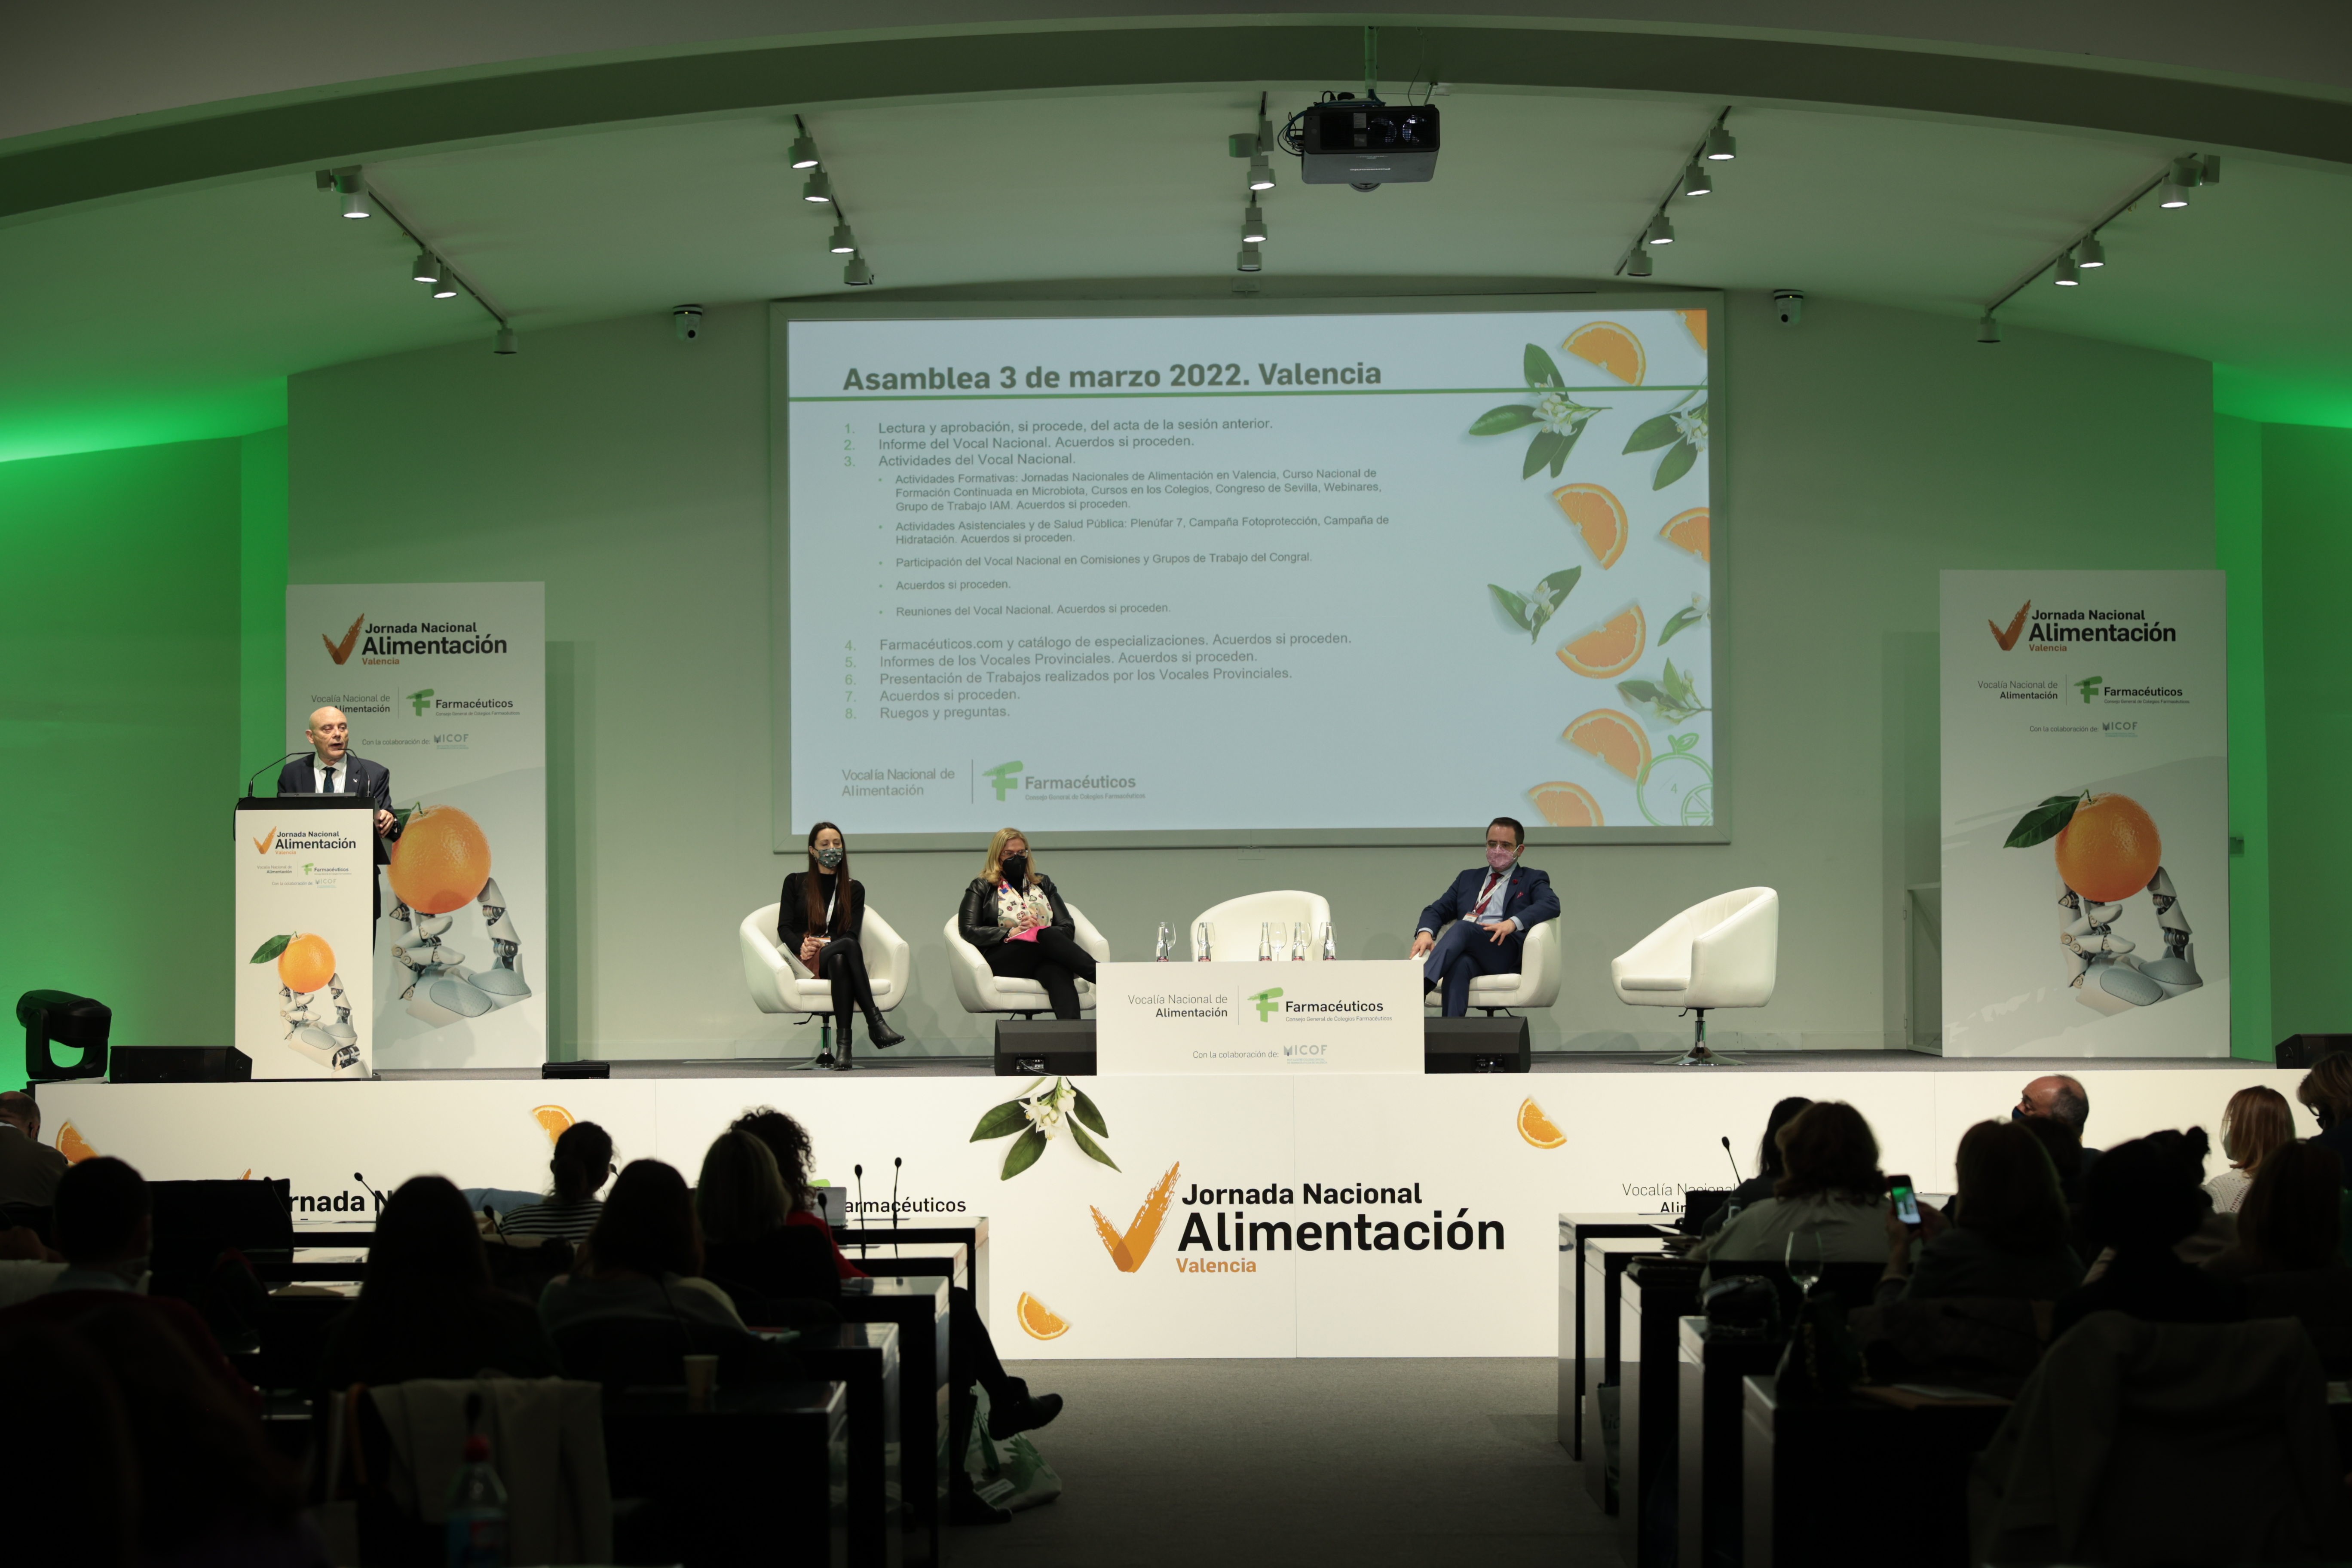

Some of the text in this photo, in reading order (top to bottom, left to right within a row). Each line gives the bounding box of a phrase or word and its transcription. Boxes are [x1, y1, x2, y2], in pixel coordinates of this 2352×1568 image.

[843, 362, 1381, 390] Asamblea 3 de marzo 2022. Valencia
[845, 418, 1272, 435] 1. Lectura y aprobación, si procede, del acta de la sesión anterior.
[844, 435, 1194, 450] 2. Informe del Vocal Nacional. Acuerdos si proceden.
[845, 453, 1075, 466] 3. Actividades del Vocal Nacional.
[895, 475, 955, 484] Actividades
[959, 474, 1018, 483] Formativas:
[1021, 473, 1069, 482] Jornadas
[1073, 472, 1129, 481] Nacionales
[1132, 472, 1145, 480] de
[1148, 471, 1213, 480] Alimentación
[1232, 470, 1279, 480] Valencia,
[1283, 470, 1313, 478] Curso
[1317, 469, 1360, 478] Nacional
[1364, 469, 1376, 478] de
[896, 579, 1011, 591] Acuerdos si proceden.
[2032, 610, 2145, 620] Jornada Nacional
[365, 622, 477, 634] Jornada Nacional
[2029, 622, 2176, 642] Alimentación
[362, 634, 506, 655] Alimentación
[845, 633, 1351, 651] 4. Farmacéuticos.com y catálogo de especializaciones. Acuerdos si proceden.
[845, 650, 1257, 667] 5. Informes de los Vocales Provinciales. Acuerdos si proceden.
[845, 668, 1292, 685] 6. Presentación de Trabajos realizados por los Vocales Provinciales.
[846, 689, 1020, 703] 7. Acuerdos si proceden.
[2104, 687, 2182, 696] Farmacéuticos
[436, 699, 513, 708] Farmacéuticos
[845, 707, 1010, 721] 8. Ruegos y preguntas.
[2103, 722, 2138, 731] MICOF
[434, 734, 469, 743] MICOF
[842, 768, 955, 781] Vocalía Nacional de
[1026, 775, 1136, 789] Farmacéuticos
[1671, 784, 1678, 793] 4
[842, 784, 924, 796] Alimentación
[276, 838, 355, 849] Alimentación
[1128, 994, 1227, 1004] Vocalía Nacional de
[1156, 1008, 1227, 1017] Alimentación
[1286, 1000, 1383, 1012] Farmacéuticos
[1283, 1045, 1327, 1057] MICOF
[1182, 1183, 1422, 1205] Jornada Nacional
[1623, 1183, 1672, 1196] Vocalía
[290, 1191, 364, 1212] rnada
[845, 1197, 966, 1213] armacéuticos
[1178, 1208, 1504, 1251] Alimentación
[1176, 1258, 1256, 1273] Valencia
